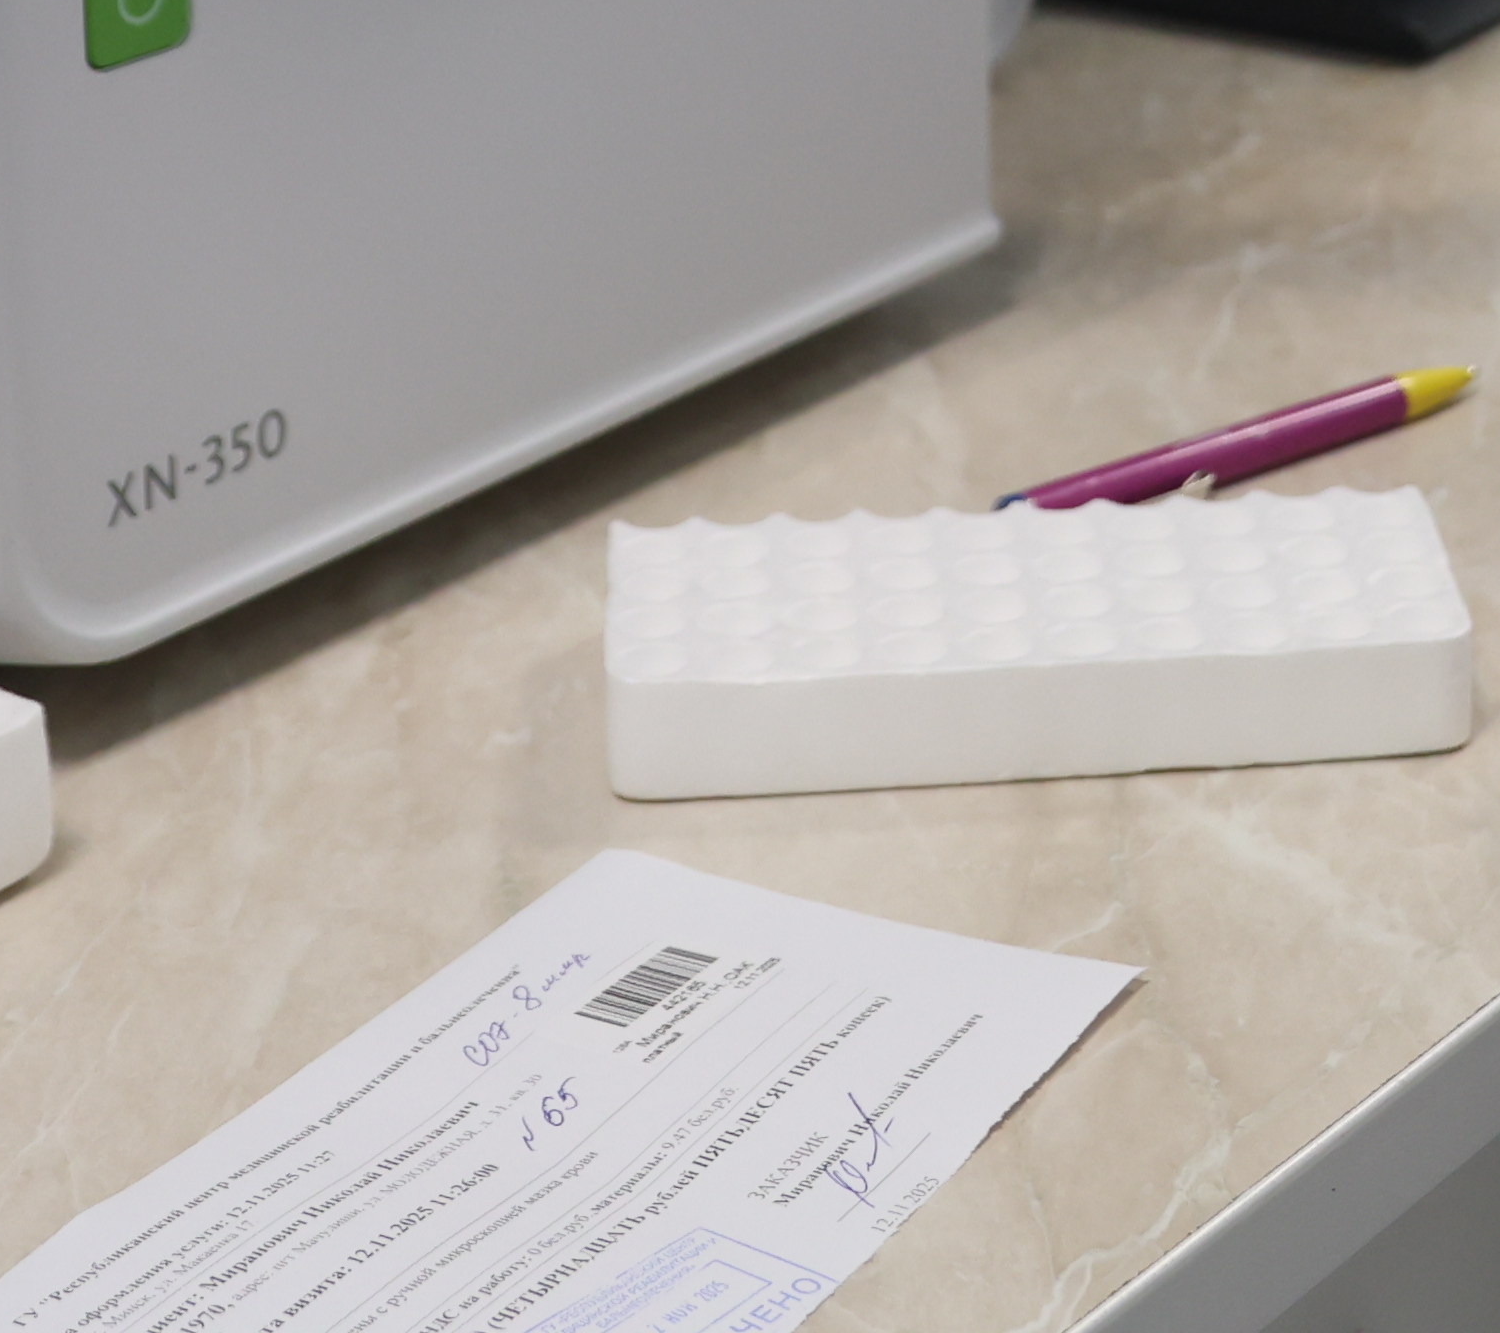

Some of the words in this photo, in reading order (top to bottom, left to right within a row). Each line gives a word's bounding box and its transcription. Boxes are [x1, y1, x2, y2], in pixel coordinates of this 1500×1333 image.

[106, 407, 288, 528] XN-350
[512, 985, 542, 1011] 8
[636, 1000, 702, 1046] Миранович
[643, 1032, 683, 1063] платный
[488, 1216, 645, 1329] (ЧЕТЫРНАДЦАТЬ
[644, 1166, 699, 1215] рублей
[693, 1081, 793, 1167] ПЯТЬДЕСЯТ
[790, 1041, 838, 1076] ПЯТЬ
[836, 997, 891, 1038] копеек)
[542, 1076, 578, 1126] 65
[747, 1132, 828, 1199] ЗАКАЗЧИК
[768, 1129, 859, 1214] Миранович
[905, 1015, 983, 1079] Николаевич
[13, 1308, 38, 1326] ГУ
[184, 1182, 229, 1209] центр
[229, 1125, 319, 1179] медицинской
[319, 1055, 411, 1125] реабилитации
[78, 1260, 172, 1326] оформления
[172, 1220, 229, 1266] услуги:
[226, 1173, 299, 1218] 12.11.2025
[297, 1151, 334, 1172] 11:27
[200, 1220, 307, 1290] Миранович
[302, 1166, 382, 1218] Николай
[379, 1102, 478, 1170] Николаевич
[284, 1267, 351, 1316] визита:
[348, 1206, 433, 1263] 12.11.2025
[431, 1164, 498, 1206] 11:26:00
[386, 1268, 437, 1307] ручной
[435, 1206, 526, 1267] микроскопией
[524, 1178, 563, 1204] мазка
[561, 1152, 598, 1179] крови
[459, 1296, 480, 1309] на
[478, 1253, 532, 1296] работу:
[662, 1128, 690, 1149] 9.47
[872, 1176, 939, 1232] 12.11.2025
